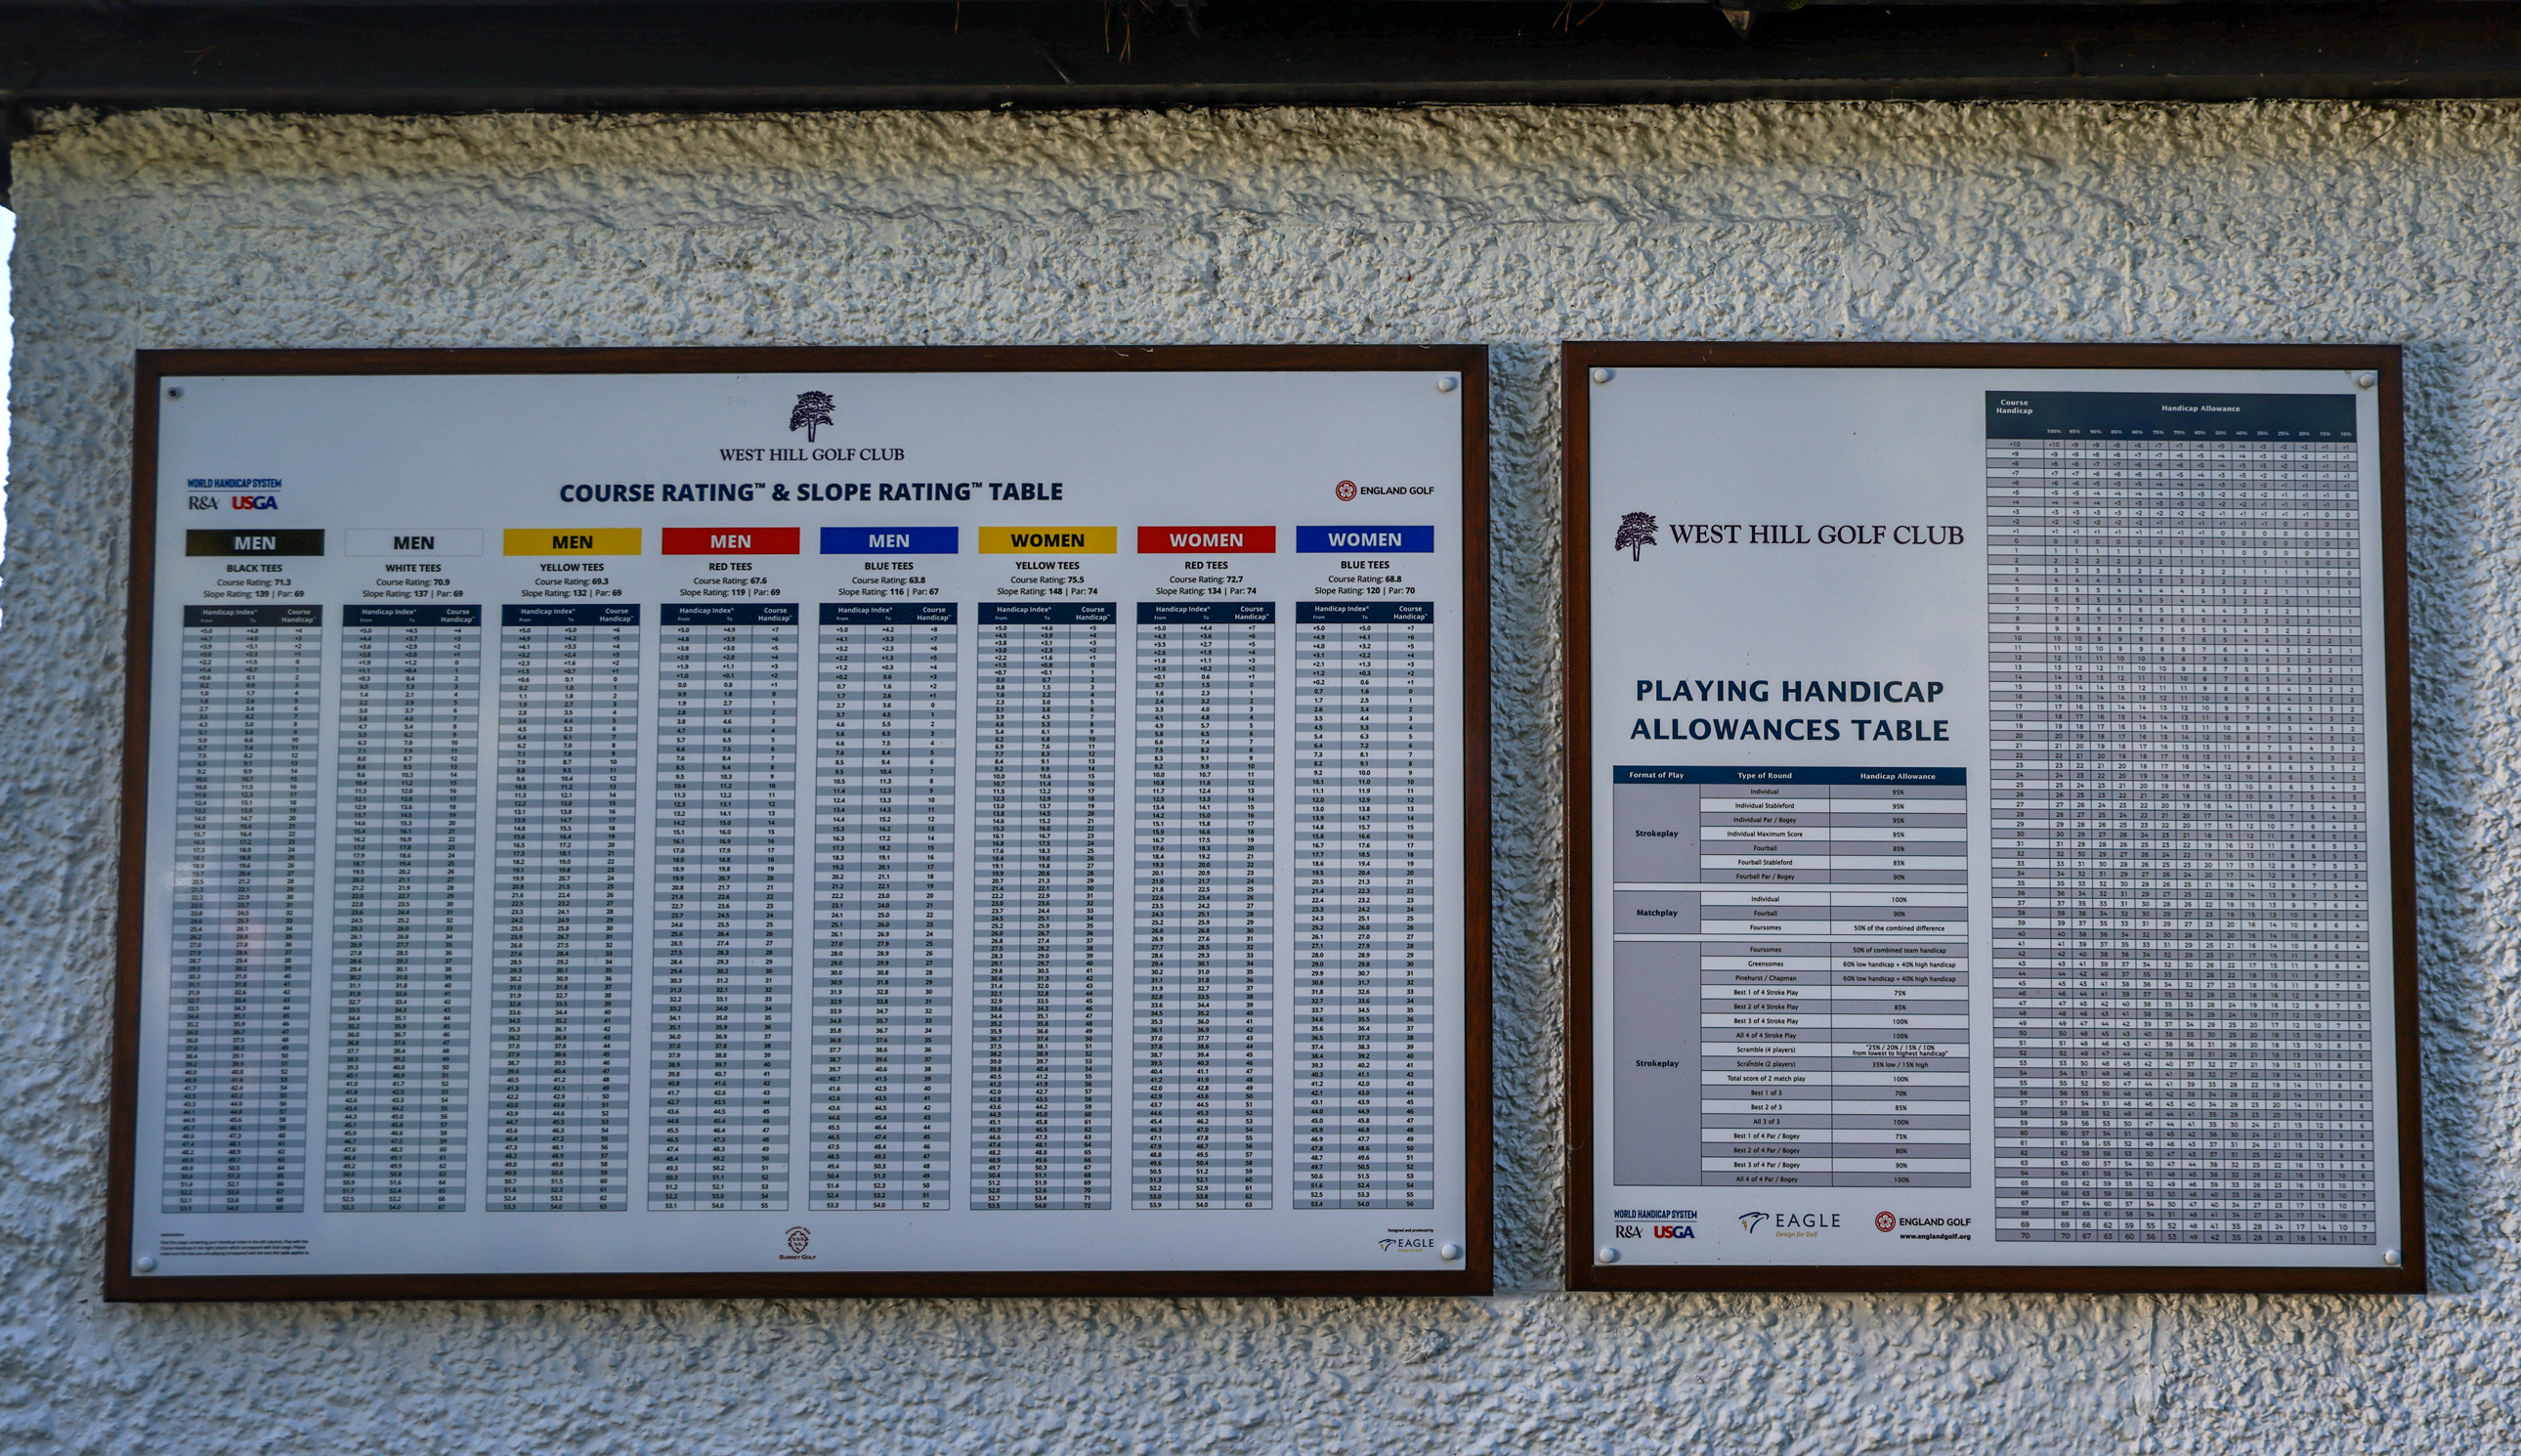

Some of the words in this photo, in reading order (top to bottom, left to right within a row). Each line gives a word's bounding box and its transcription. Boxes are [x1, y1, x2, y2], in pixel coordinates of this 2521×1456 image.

[1996, 407, 2033, 415] Handicap
[2161, 405, 2199, 413] Handicap
[719, 448, 766, 461] WEST
[769, 448, 809, 461] HILL
[812, 448, 856, 461] GOLF
[859, 448, 905, 461] CLUB
[188, 479, 214, 488] WORLD
[214, 479, 252, 488] HANDICAP
[252, 479, 282, 488] SYSTEM
[559, 483, 656, 503] COURSE
[771, 483, 790, 502] &
[796, 483, 872, 502] SLOPE
[988, 482, 1063, 501] TABLE
[1360, 486, 1408, 495] ENGLAND
[1408, 486, 1434, 495] GOLF
[189, 495, 221, 510] R&A
[232, 495, 279, 510] USGA
[1328, 533, 1402, 546] WOMEN
[1668, 524, 1742, 544] WEST
[1748, 524, 1812, 544] HILL
[1817, 524, 1887, 545] GOLF
[1893, 525, 1965, 545] CLUB
[234, 535, 277, 550] MEN
[393, 535, 435, 550] MEN
[552, 535, 593, 550] MEN
[710, 535, 751, 549] MEN
[869, 534, 910, 548] MEN
[1010, 533, 1085, 548] WOMEN
[1169, 533, 1244, 547] WOMEN
[226, 564, 259, 573] BLACK
[260, 564, 283, 573] TEES
[385, 563, 417, 573] WHITE
[418, 563, 442, 573] TEES
[539, 563, 581, 573] YELLOW
[581, 563, 605, 572] TEES
[708, 562, 729, 572] RED
[730, 562, 753, 572] TEES
[864, 561, 890, 571] BLUE
[891, 561, 915, 571] TEES
[1015, 561, 1056, 571] YELLOW
[1057, 561, 1081, 571] TEES
[1184, 561, 1205, 570] RED
[1205, 561, 1229, 570] TEES
[1341, 560, 1366, 570] BLUE
[1367, 560, 1390, 570] TEES
[216, 578, 245, 587] Course
[245, 578, 274, 588] Rating:
[274, 578, 292, 586] 71.3
[534, 578, 563, 586] Course
[564, 578, 591, 587] Rating:
[591, 577, 610, 585] 69.3
[693, 577, 721, 585] Course
[722, 577, 749, 587] Rating:
[749, 577, 768, 585] 67.6
[851, 576, 879, 584] Course
[880, 576, 908, 586] Rating:
[908, 576, 926, 584] 63.8
[1169, 576, 1197, 584] Course
[1198, 576, 1225, 585] Rating:
[1225, 575, 1244, 583] 72.7
[1328, 575, 1356, 583] Course
[1356, 575, 1384, 585] Rating:
[1385, 575, 1402, 583] 68.8
[202, 589, 226, 600] Slope
[226, 589, 254, 600] Rating:
[254, 589, 271, 598] 139
[277, 589, 293, 598] Par:
[293, 589, 306, 598] 69
[1314, 586, 1337, 596] Slope
[1338, 586, 1365, 597] Rating:
[1366, 586, 1382, 595] 120
[1389, 586, 1404, 595] Par:
[1405, 586, 1416, 595] 70
[1637, 679, 1769, 703] PLAYING
[1782, 680, 1944, 704] HANDICAP
[1630, 717, 1841, 742] ALLOWANCES
[1851, 719, 1949, 742] TABLE
[1668, 771, 1685, 780] Play
[1859, 772, 1896, 781] Handicap
[1778, 816, 1797, 825] Bogey
[1635, 830, 1679, 838] Strokeplay
[1636, 909, 1679, 919] Matchplay
[1635, 1059, 1680, 1069] Strokeplay
[1915, 1061, 1929, 1070] high
[1613, 1210, 1637, 1219] WORLD
[1638, 1210, 1671, 1219] HANDICAP
[1672, 1210, 1697, 1219] SYSTEM
[1775, 1213, 1841, 1228] EAGLE
[1899, 1218, 1945, 1226] ENGLAND
[1945, 1218, 1972, 1226] GOLF
[1615, 1224, 1644, 1239] R&A
[1653, 1224, 1695, 1239] USGA
[1775, 1230, 1796, 1239] Design
[1796, 1230, 1806, 1239] for
[1805, 1230, 1818, 1239] Golf
[1900, 1232, 1972, 1241] www.englandgolf.org
[1397, 1238, 1434, 1248] EAGLE
